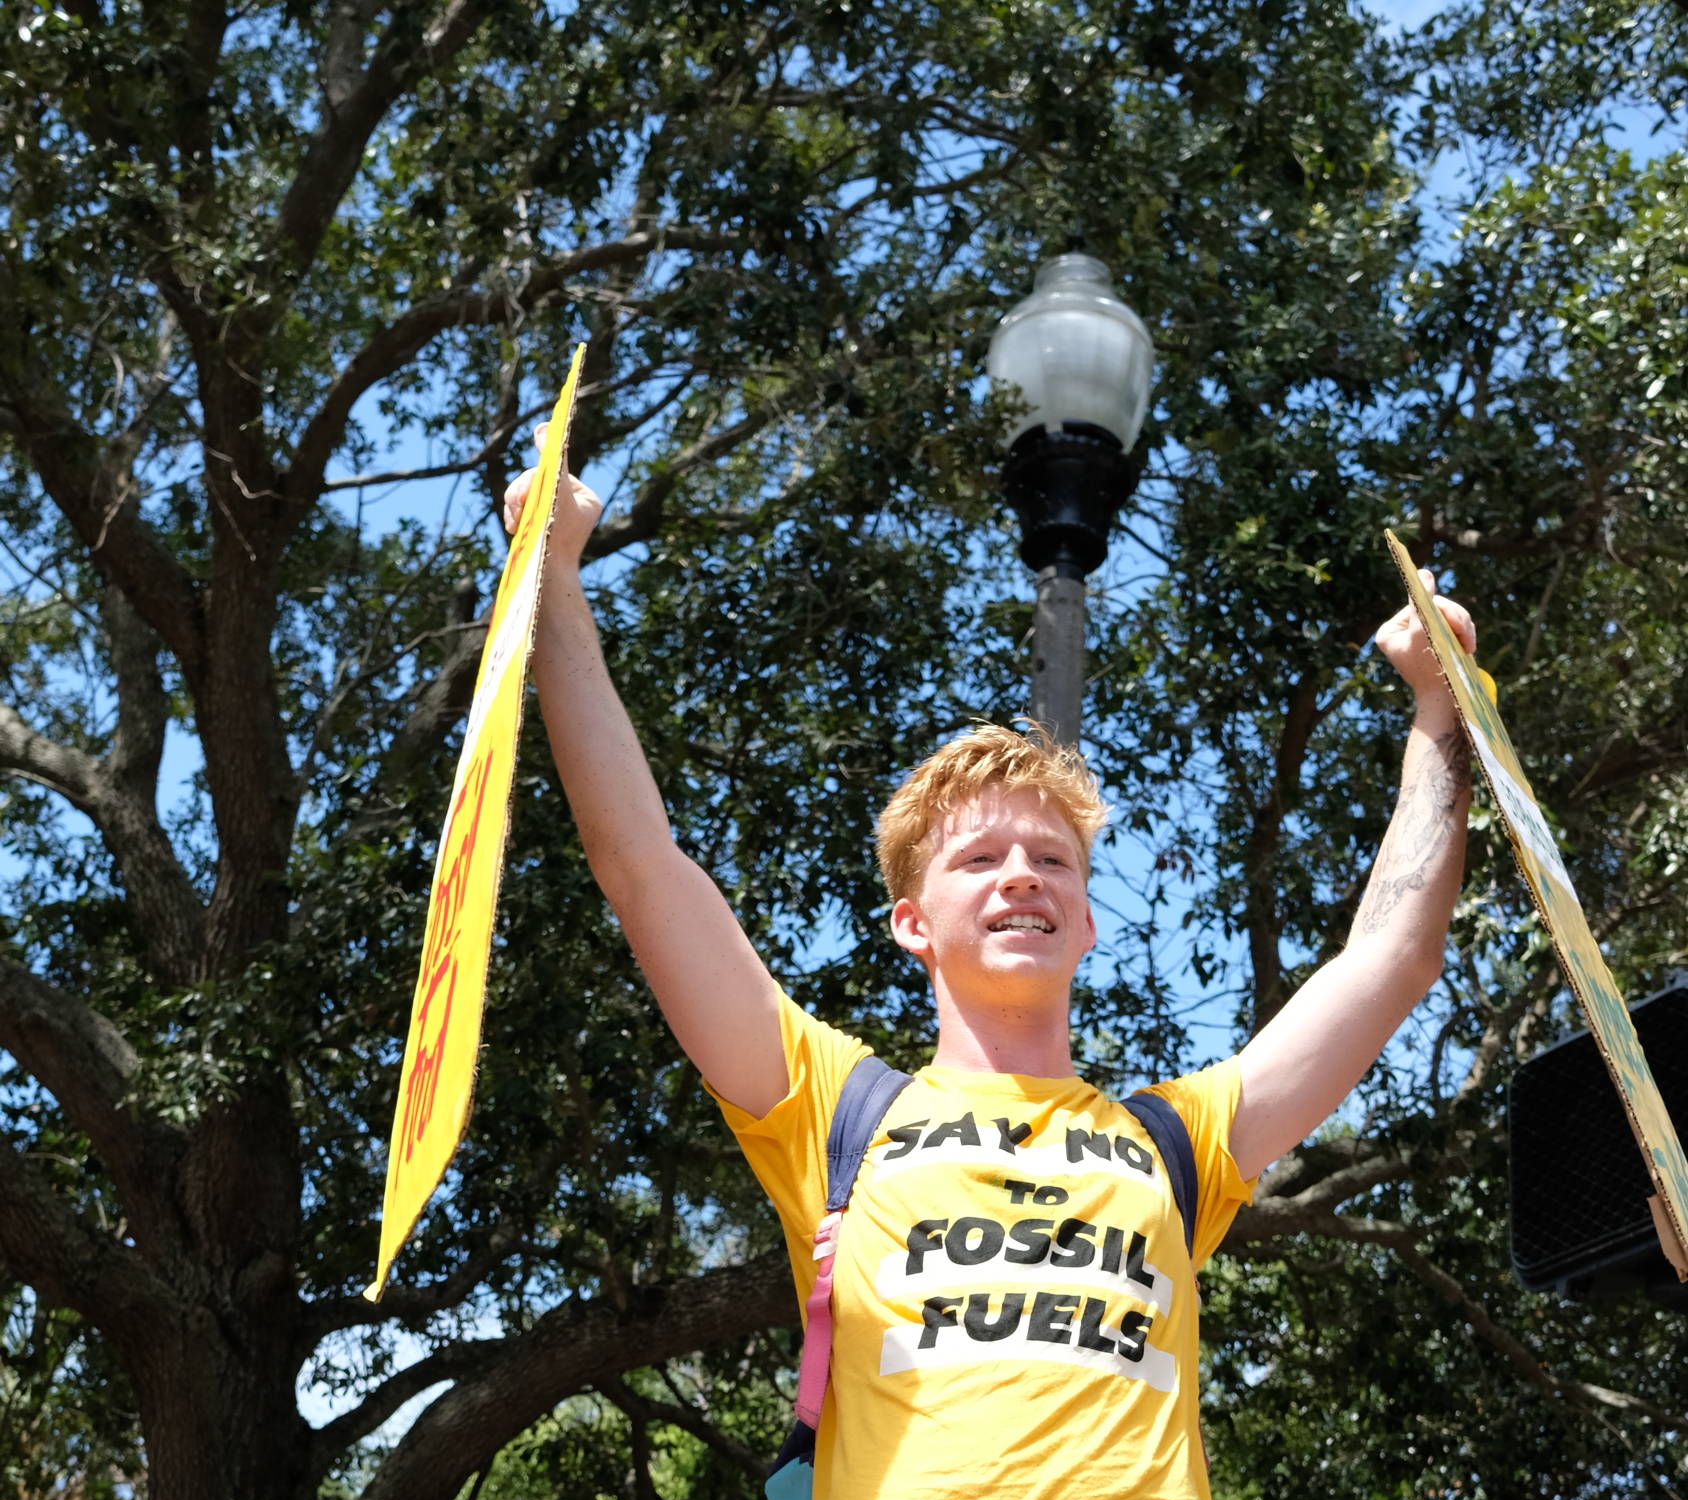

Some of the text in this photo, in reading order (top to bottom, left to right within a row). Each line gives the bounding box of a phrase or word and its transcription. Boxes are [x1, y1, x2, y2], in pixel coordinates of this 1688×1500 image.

[883, 1111, 1154, 1175] SAY NO
[1003, 1178, 1069, 1206] TO
[905, 1216, 1155, 1289] FOSSIL
[917, 1292, 1153, 1363] FUELS
